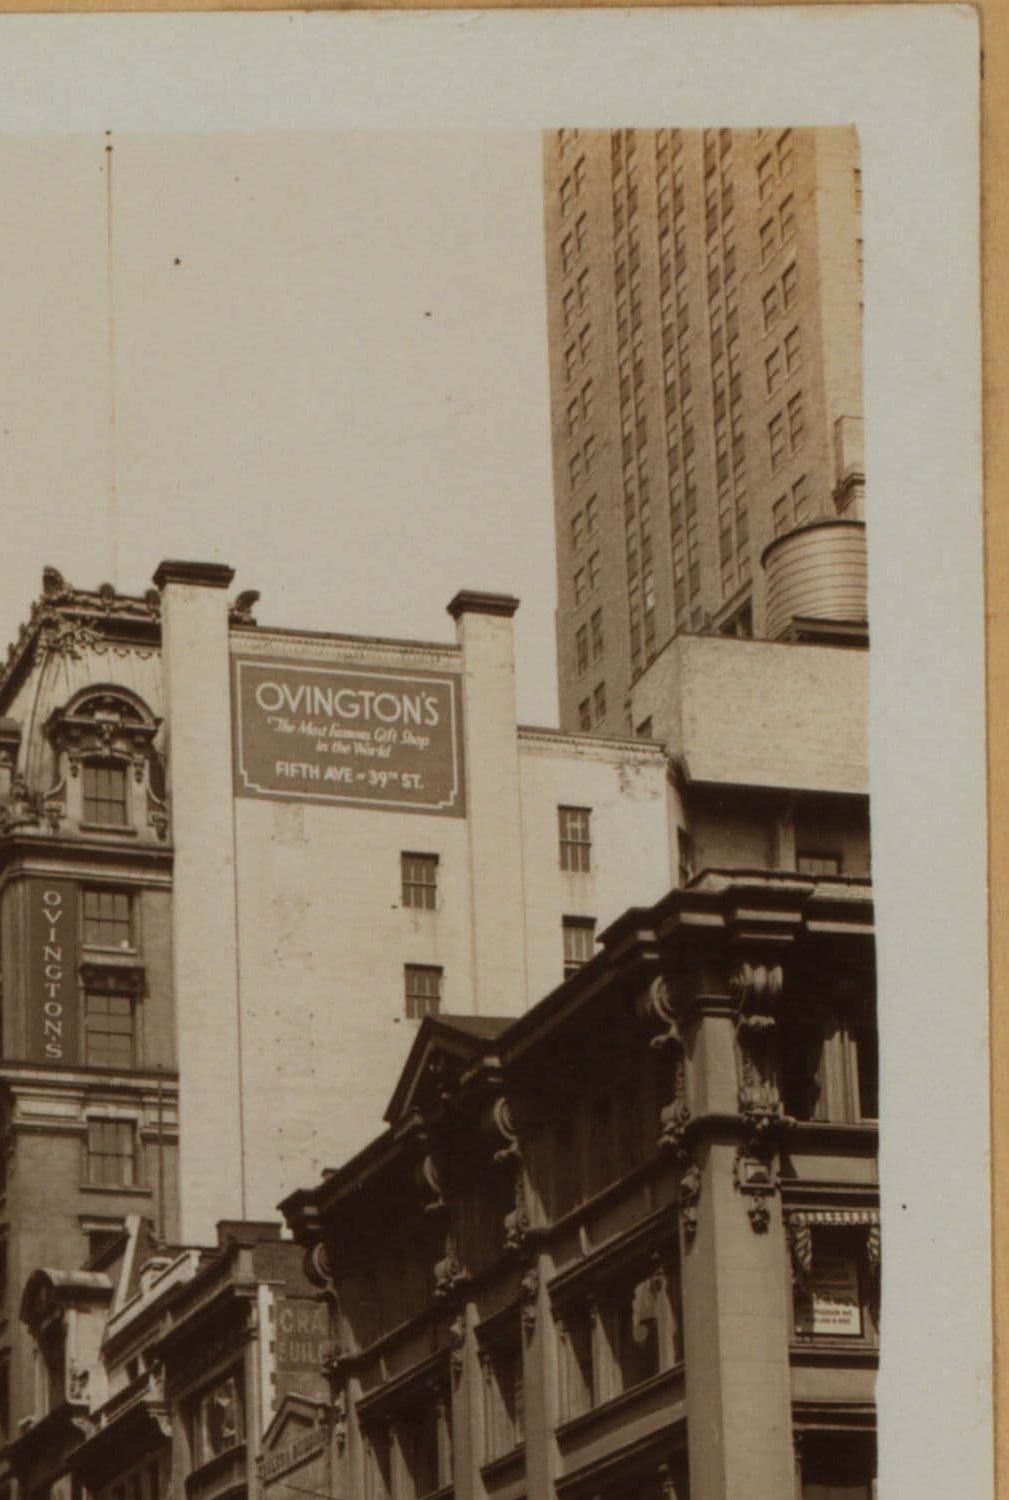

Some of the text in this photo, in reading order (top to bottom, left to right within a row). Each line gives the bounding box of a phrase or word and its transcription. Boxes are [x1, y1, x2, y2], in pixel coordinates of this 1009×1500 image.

[255, 682, 440, 726] OVINGTON'S
[267, 717, 430, 749] The Most Famous Gift Shop
[315, 740, 392, 758] in the World
[275, 761, 320, 779] FIFTH
[401, 772, 424, 790] ST.
